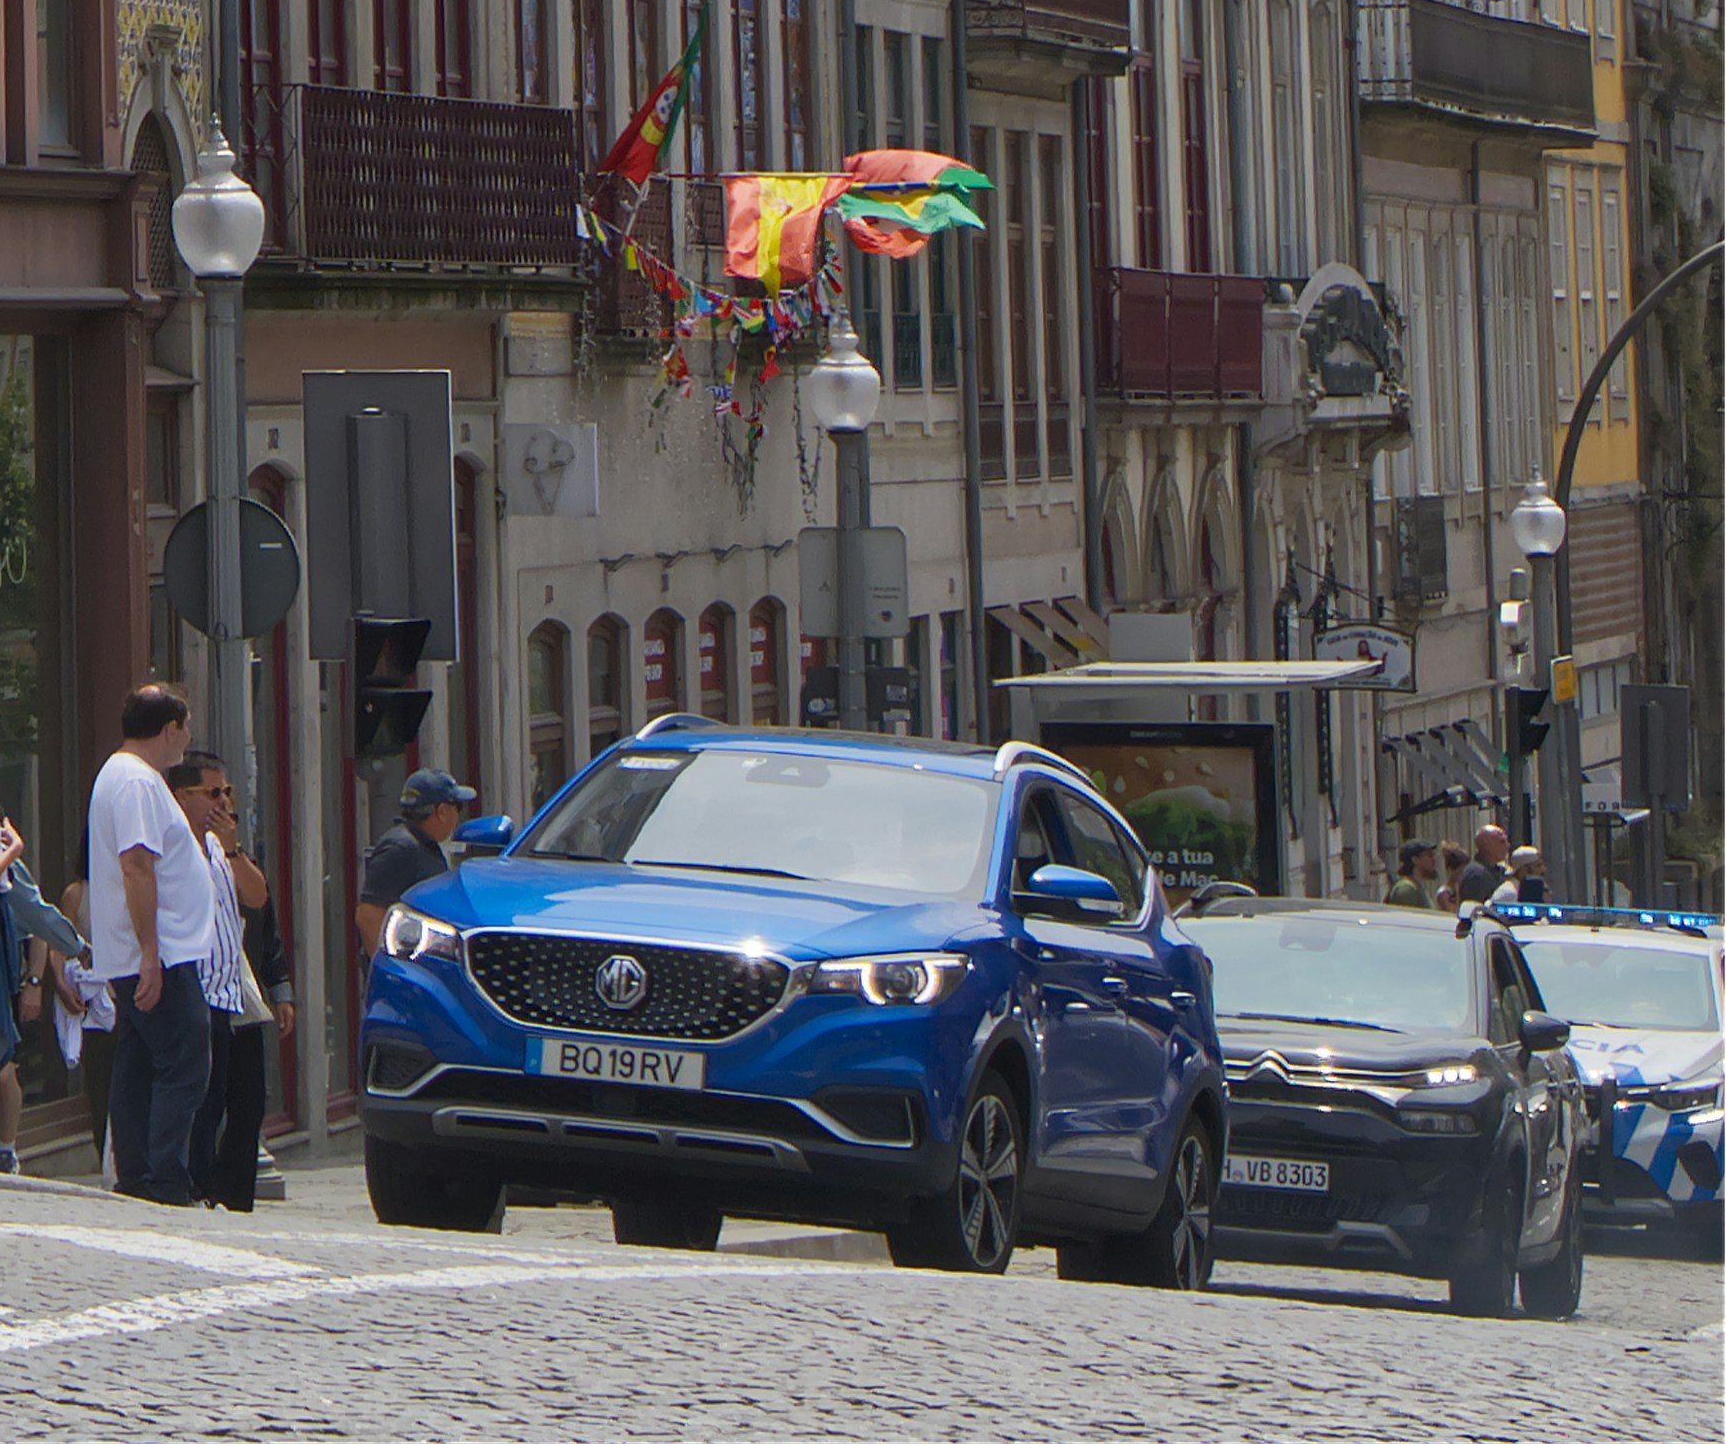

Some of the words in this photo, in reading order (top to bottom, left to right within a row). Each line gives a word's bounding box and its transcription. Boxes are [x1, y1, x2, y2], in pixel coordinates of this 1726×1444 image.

[1167, 851, 1179, 865] a
[1182, 848, 1214, 865] tua
[600, 959, 641, 1003] MG
[1246, 1160, 1271, 1183] VB
[1276, 1162, 1327, 1188] 8303
